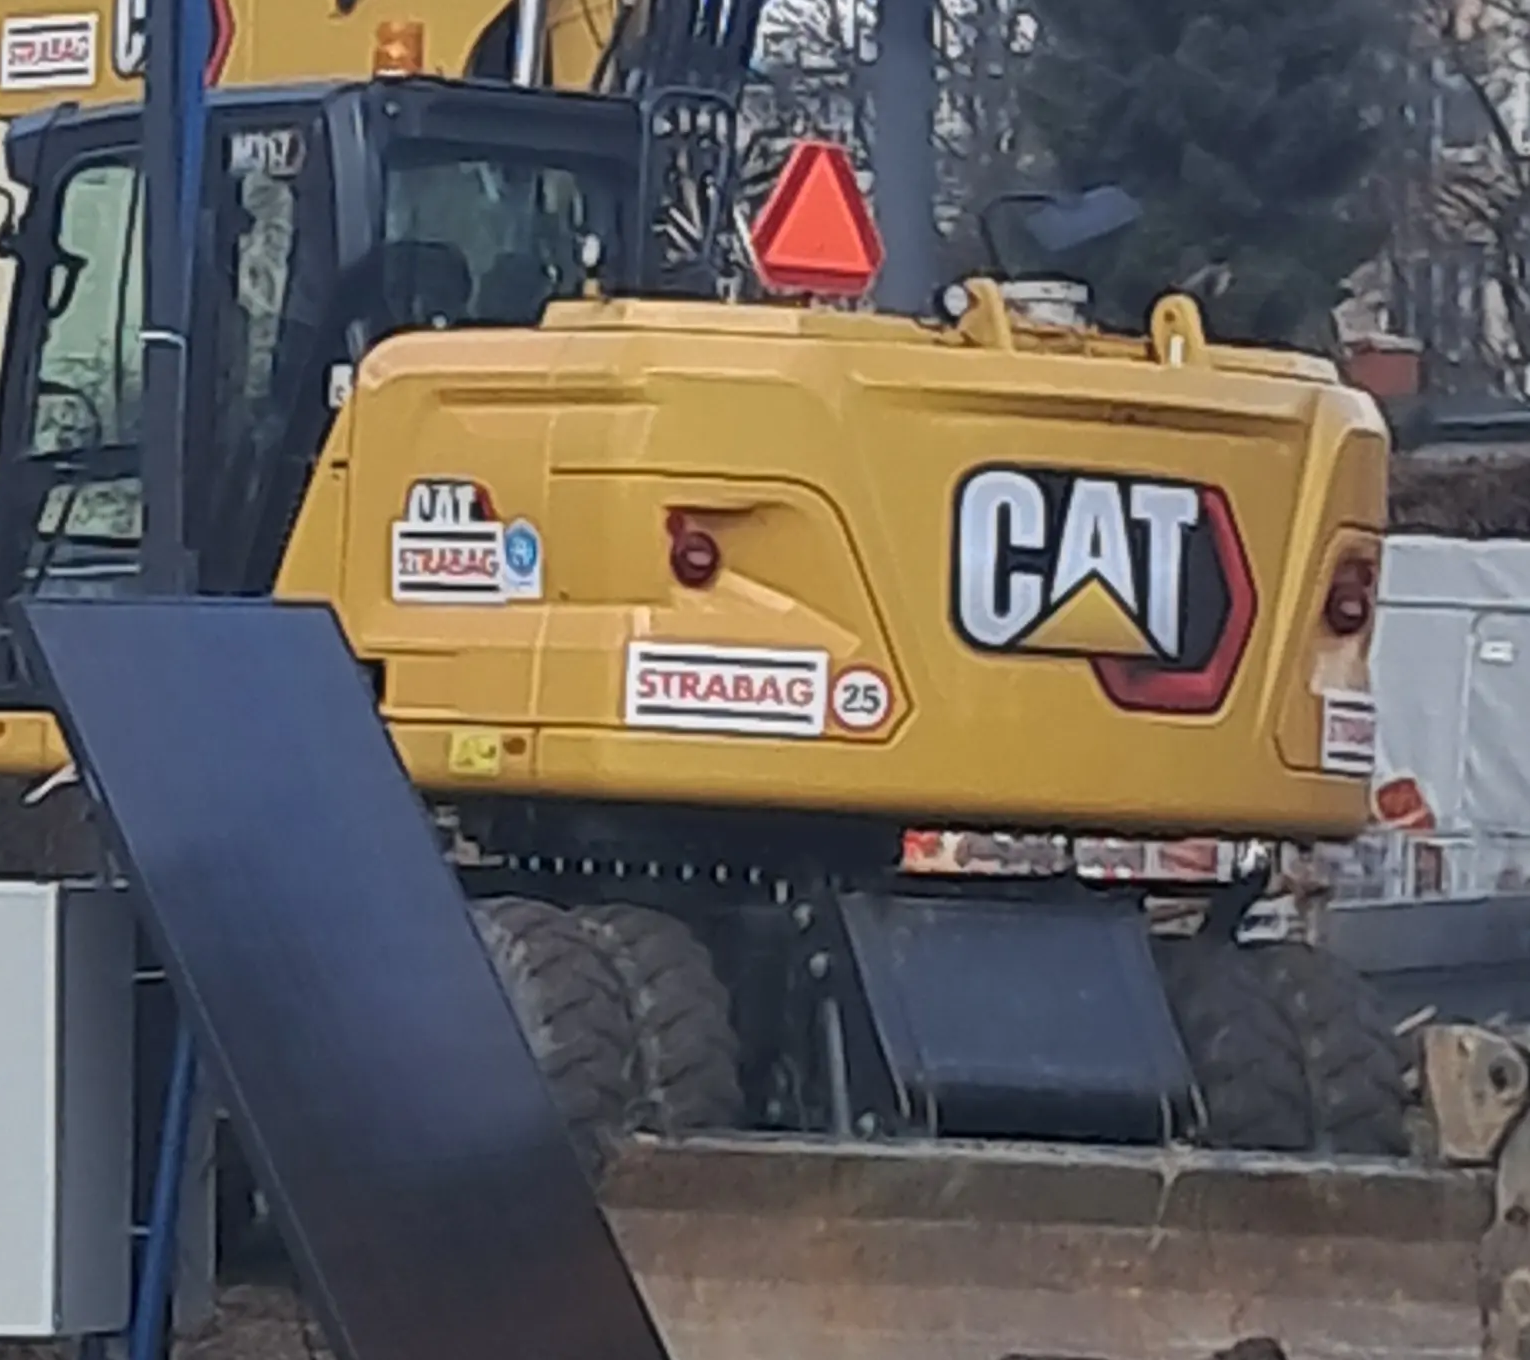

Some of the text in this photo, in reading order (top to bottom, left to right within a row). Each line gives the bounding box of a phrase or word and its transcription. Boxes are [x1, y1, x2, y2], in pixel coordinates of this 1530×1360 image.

[960, 470, 1201, 656] CAT
[636, 668, 816, 707] STRABAG
[841, 683, 882, 716] 25
